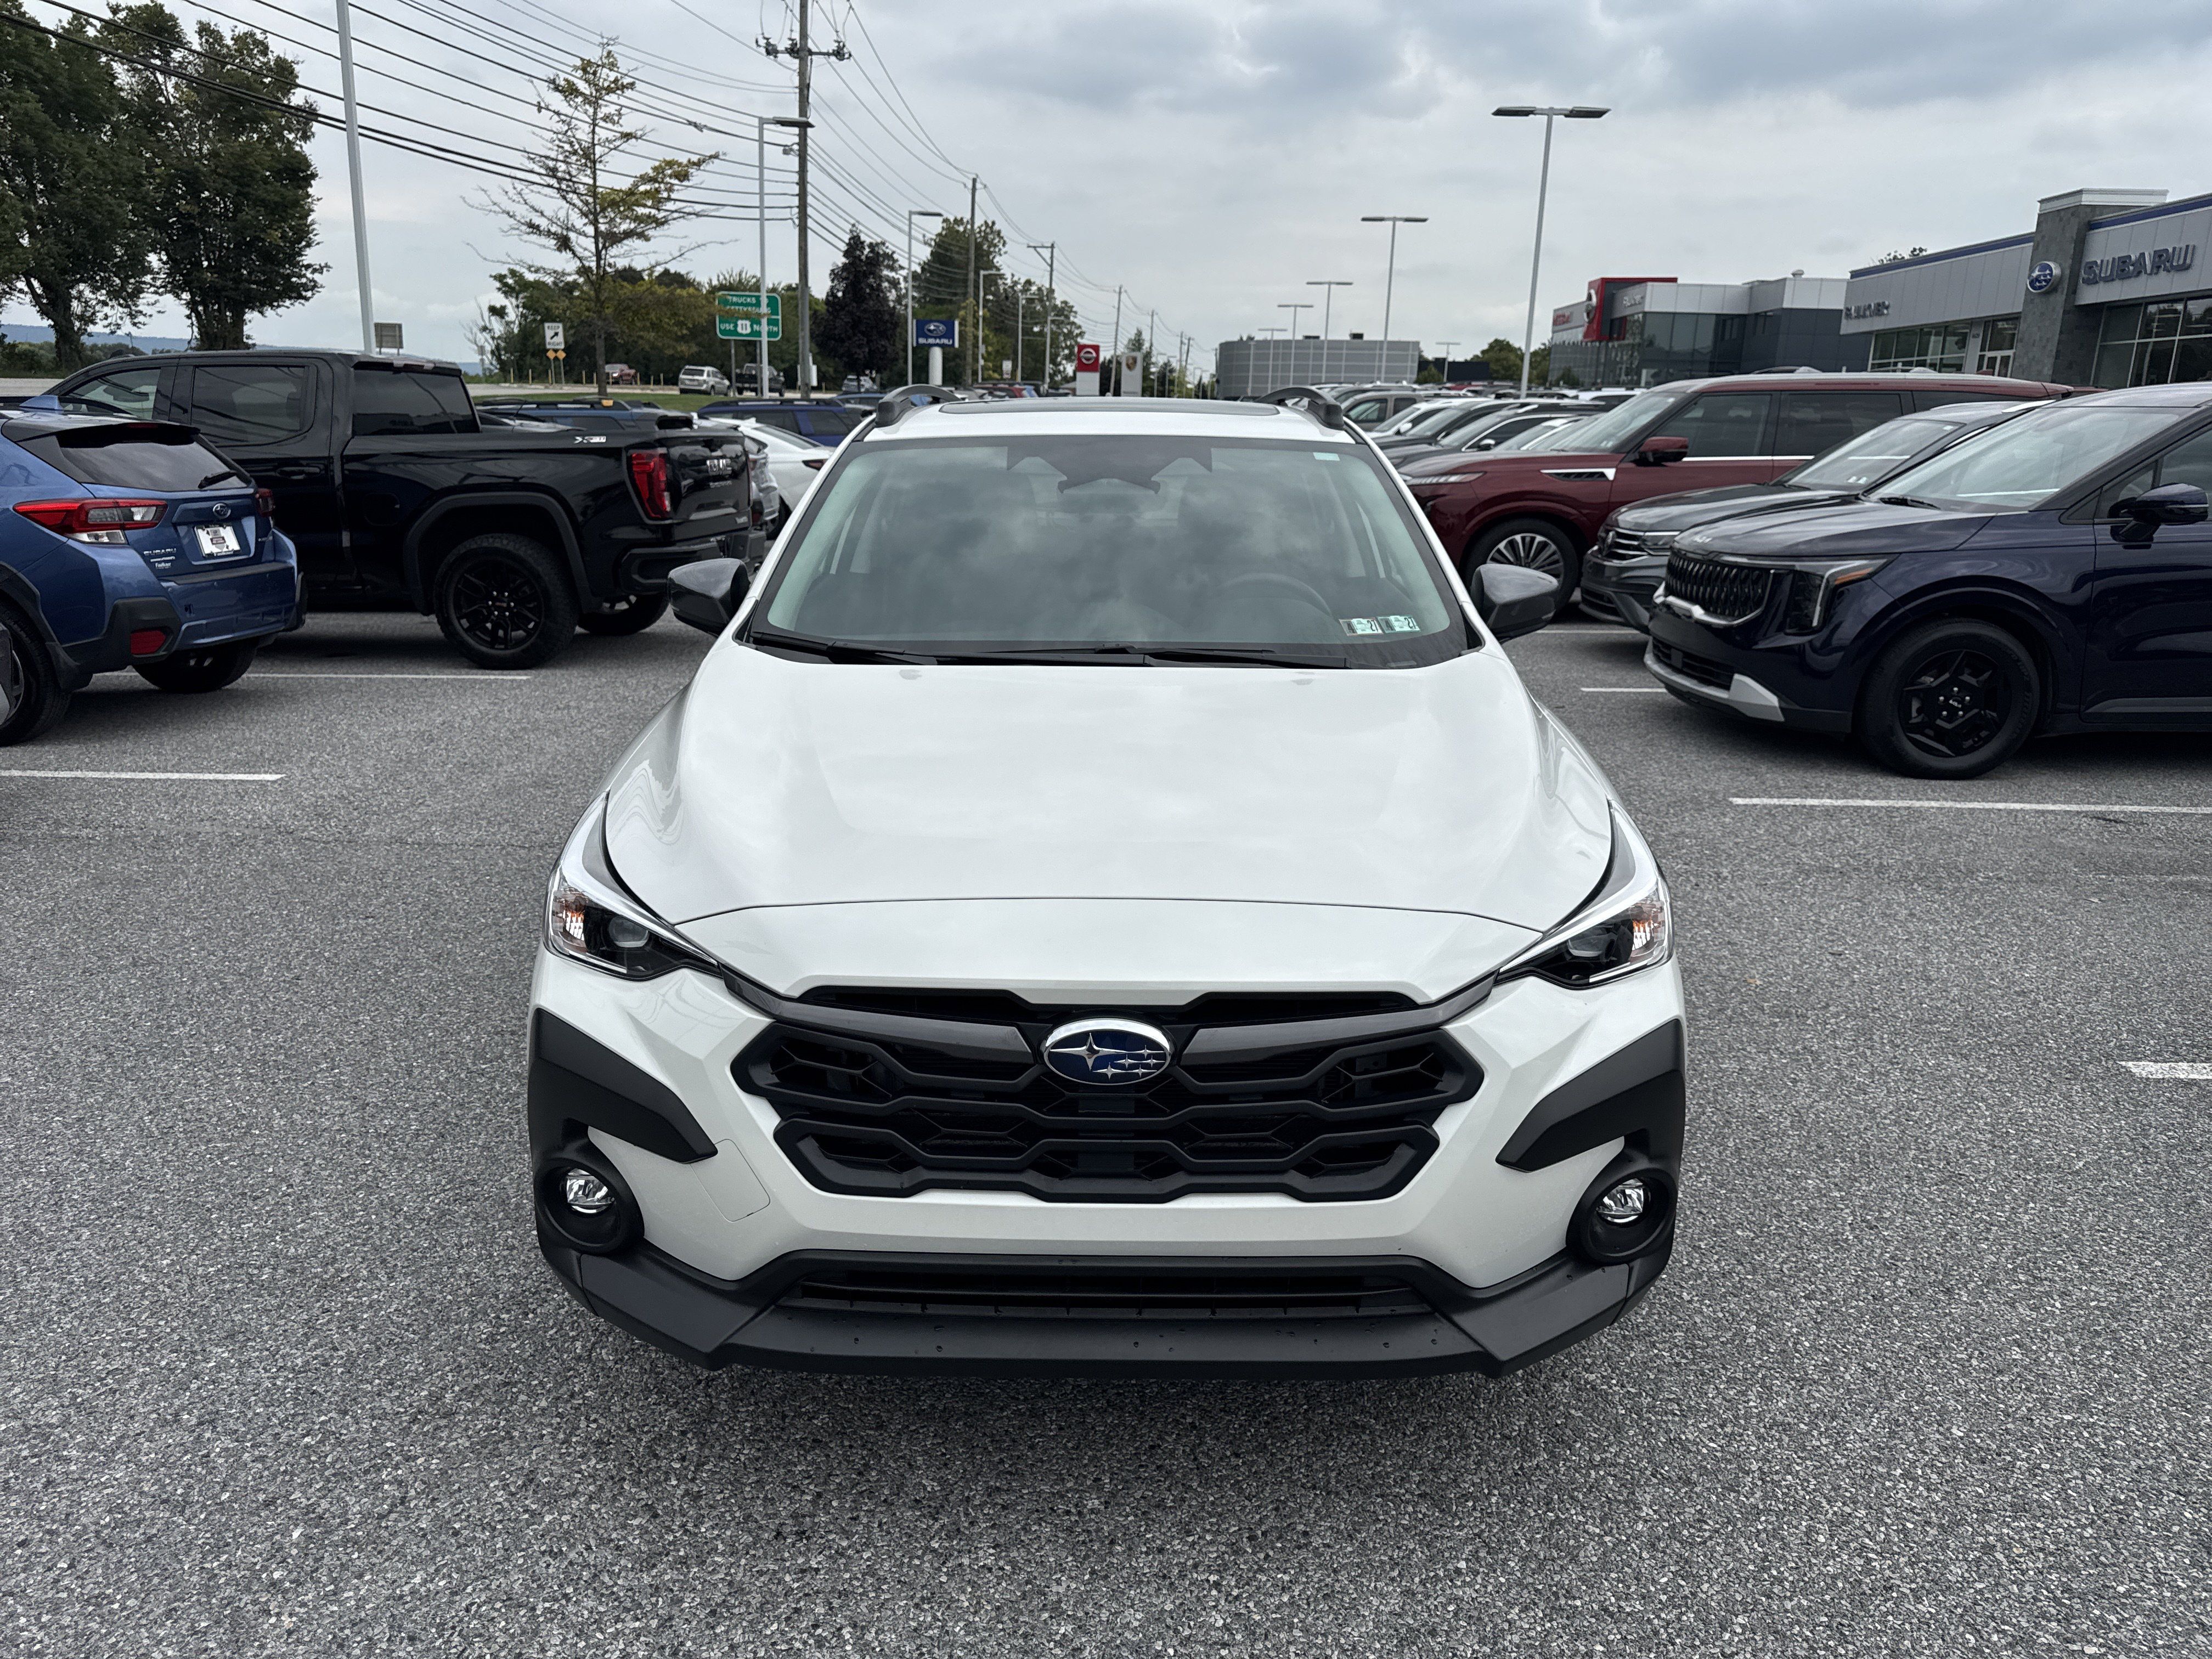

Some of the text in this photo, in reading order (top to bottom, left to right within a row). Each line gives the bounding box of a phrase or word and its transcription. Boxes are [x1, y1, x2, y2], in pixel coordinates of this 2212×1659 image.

[2081, 244, 2196, 285] SUBARU
[740, 323, 748, 331] 11
[753, 324, 778, 332] NTH
